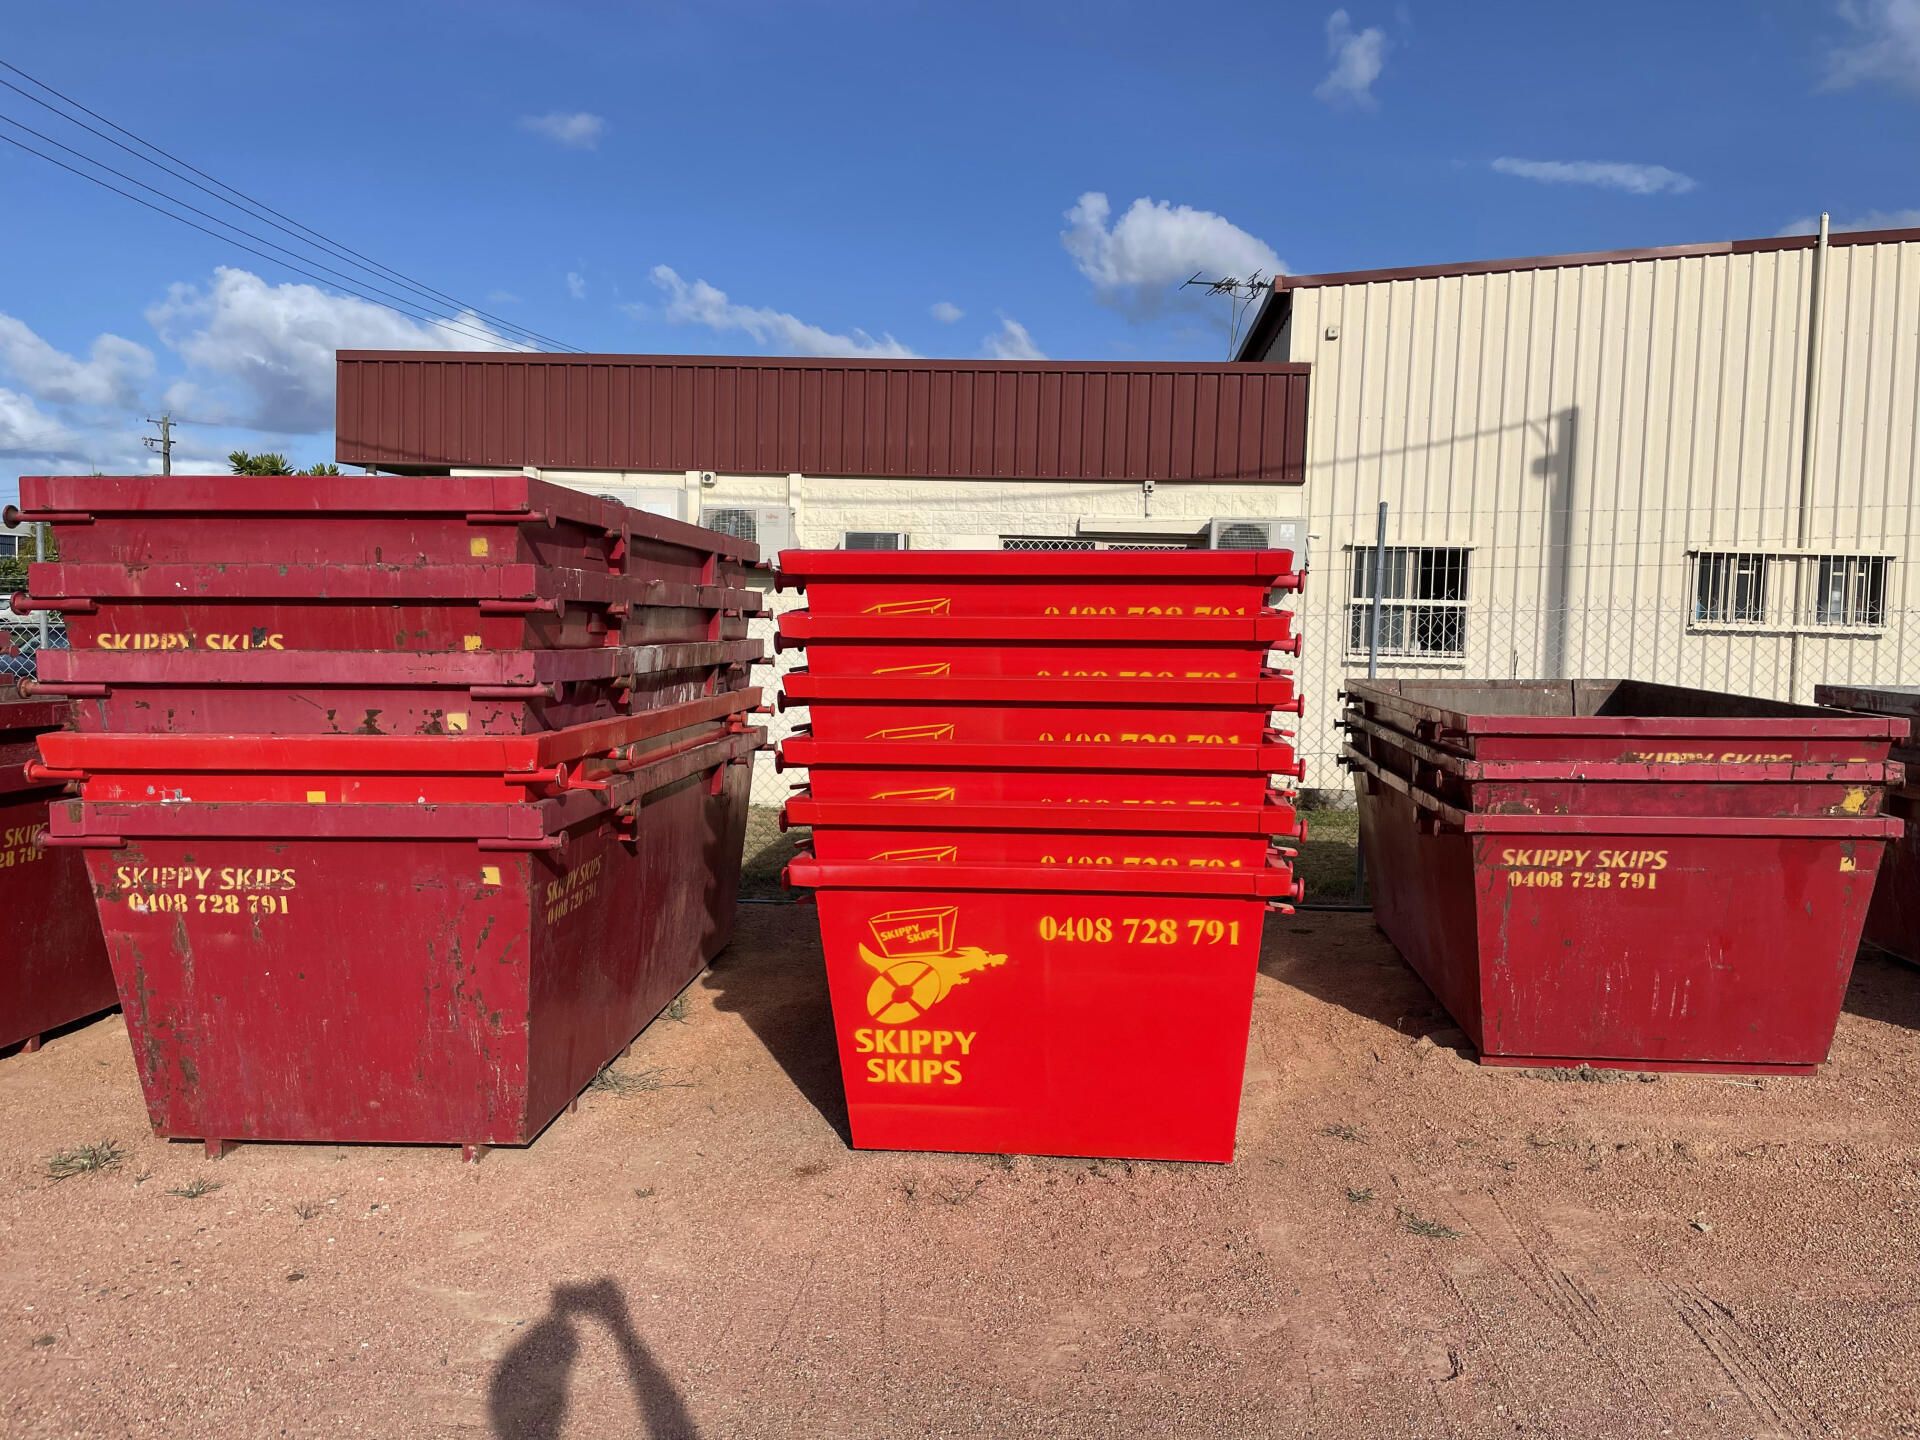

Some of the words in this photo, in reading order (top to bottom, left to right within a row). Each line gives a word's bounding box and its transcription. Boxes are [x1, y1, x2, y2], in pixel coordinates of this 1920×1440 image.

[206, 633, 285, 650] SKIS
[1502, 849, 1592, 868] SKIPPY
[1596, 849, 1668, 870] SKIPS
[117, 866, 212, 890] SKIPPY
[220, 867, 296, 890] SKIPS
[1509, 872, 1563, 889] 0408
[1571, 872, 1610, 889] 728
[1618, 872, 1657, 890] 791
[128, 892, 189, 914] 0408
[196, 893, 240, 914] 728
[247, 893, 289, 914] 791
[880, 923, 920, 941] SKIPPY
[907, 927, 939, 944] SKIPS
[1039, 915, 1113, 943] 0408
[1122, 918, 1178, 944] 728
[1187, 919, 1239, 945] 791
[854, 1028, 977, 1055] SKIPPY
[866, 1058, 963, 1085] SKIPS
